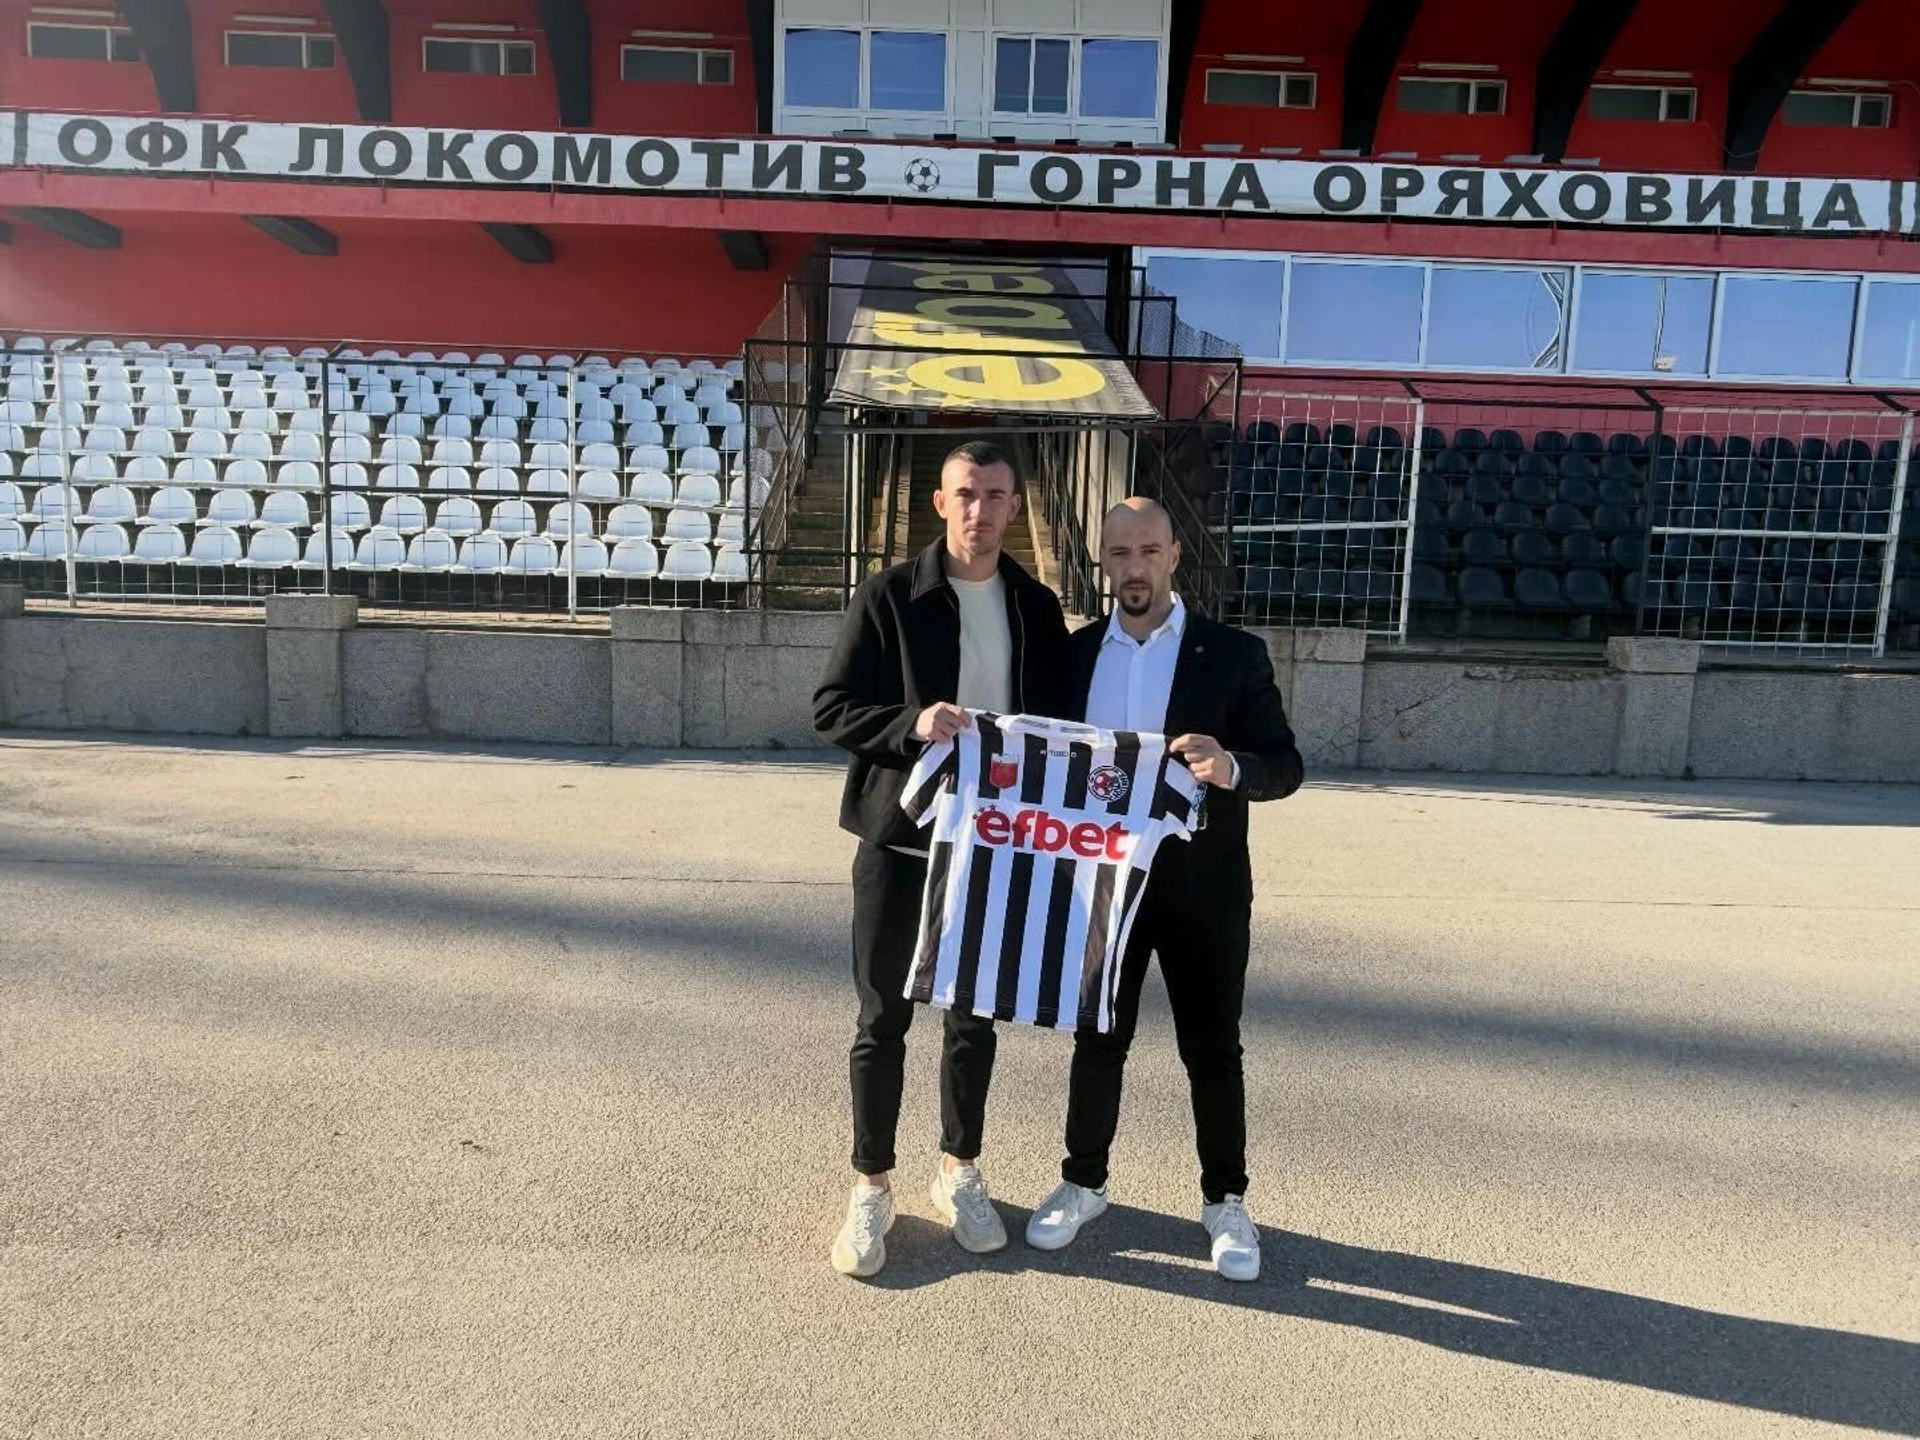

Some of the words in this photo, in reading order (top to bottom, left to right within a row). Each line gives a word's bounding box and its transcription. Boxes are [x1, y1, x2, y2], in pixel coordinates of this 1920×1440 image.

[57, 118, 248, 171] ОФК
[289, 126, 867, 191] ЛОКОМОТИВ
[976, 153, 1271, 209] ГОРНА
[1313, 165, 1866, 229] ОРЯХОВИЦА
[976, 809, 1130, 861] efbet
